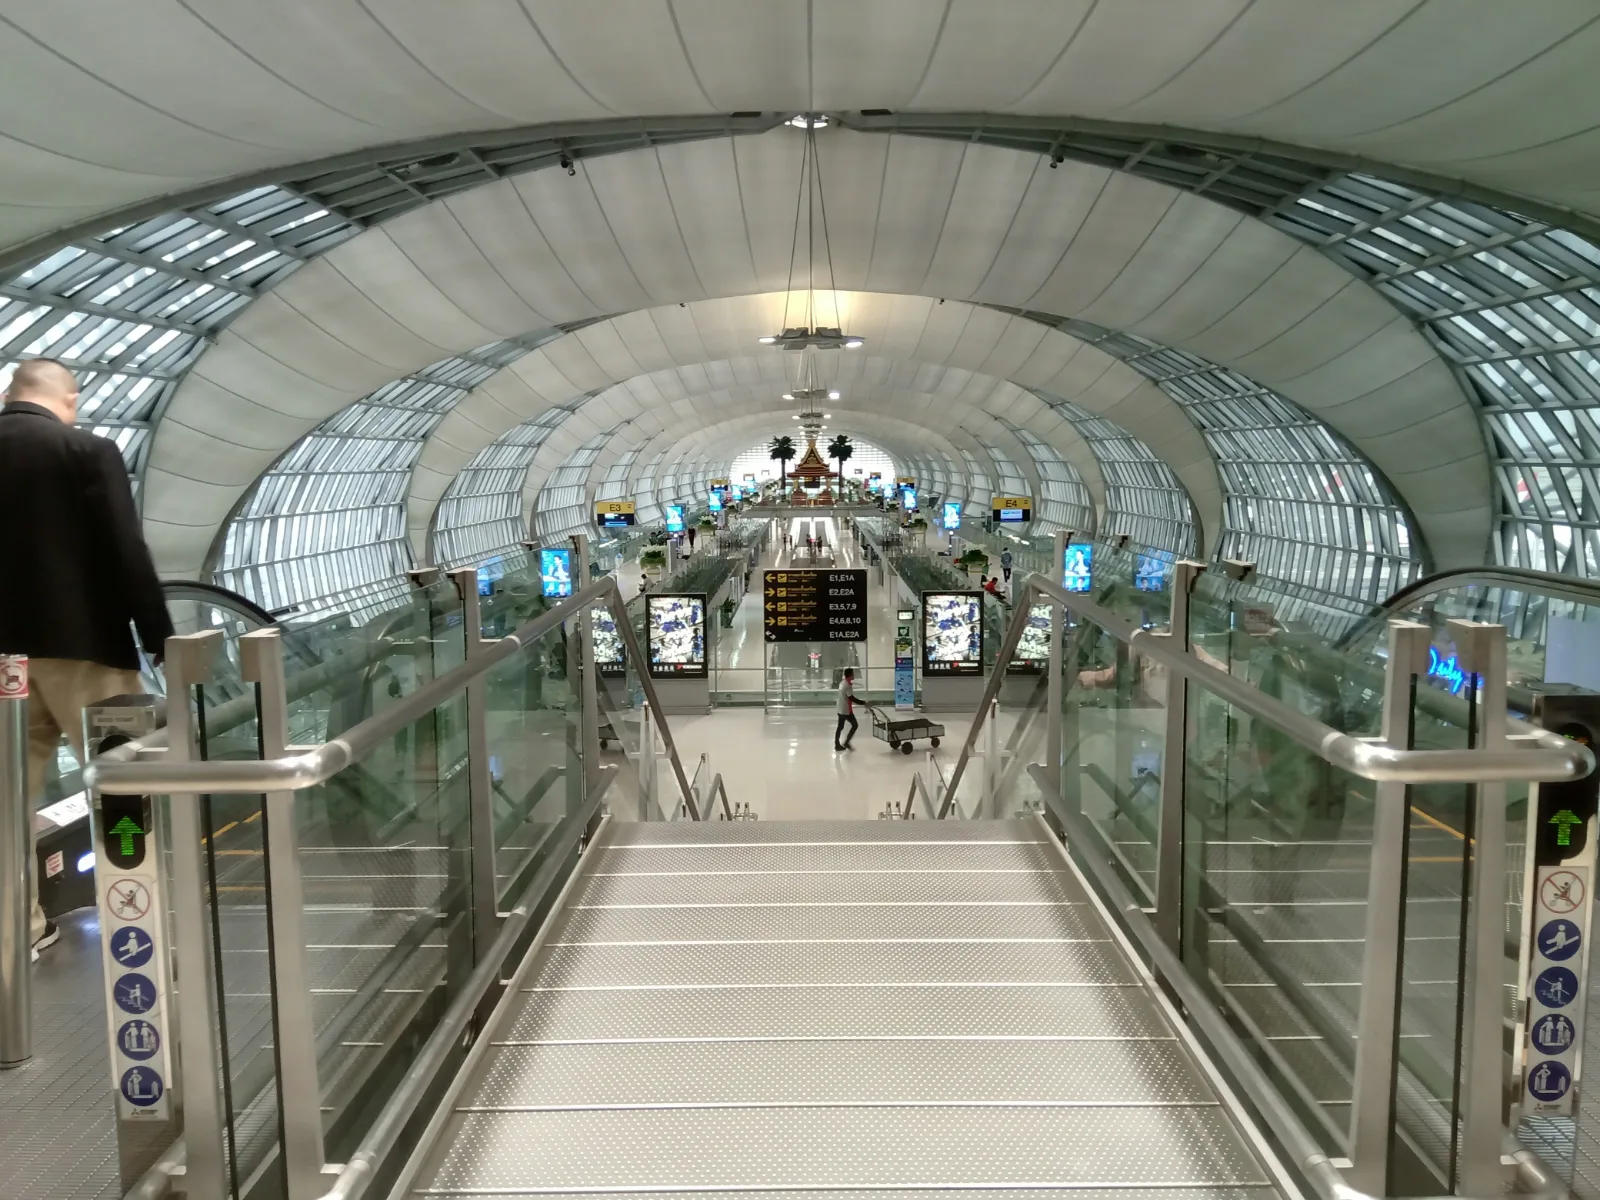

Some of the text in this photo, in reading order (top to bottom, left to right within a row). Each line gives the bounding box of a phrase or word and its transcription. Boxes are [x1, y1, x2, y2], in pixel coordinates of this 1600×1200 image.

[609, 503, 622, 512] E3
[1005, 499, 1018, 508] E4
[829, 574, 855, 582] E1,E1A
[828, 588, 855, 596] E2,E2A
[828, 603, 857, 611] E3,5,7,9
[828, 617, 861, 625] E4,6,8,10
